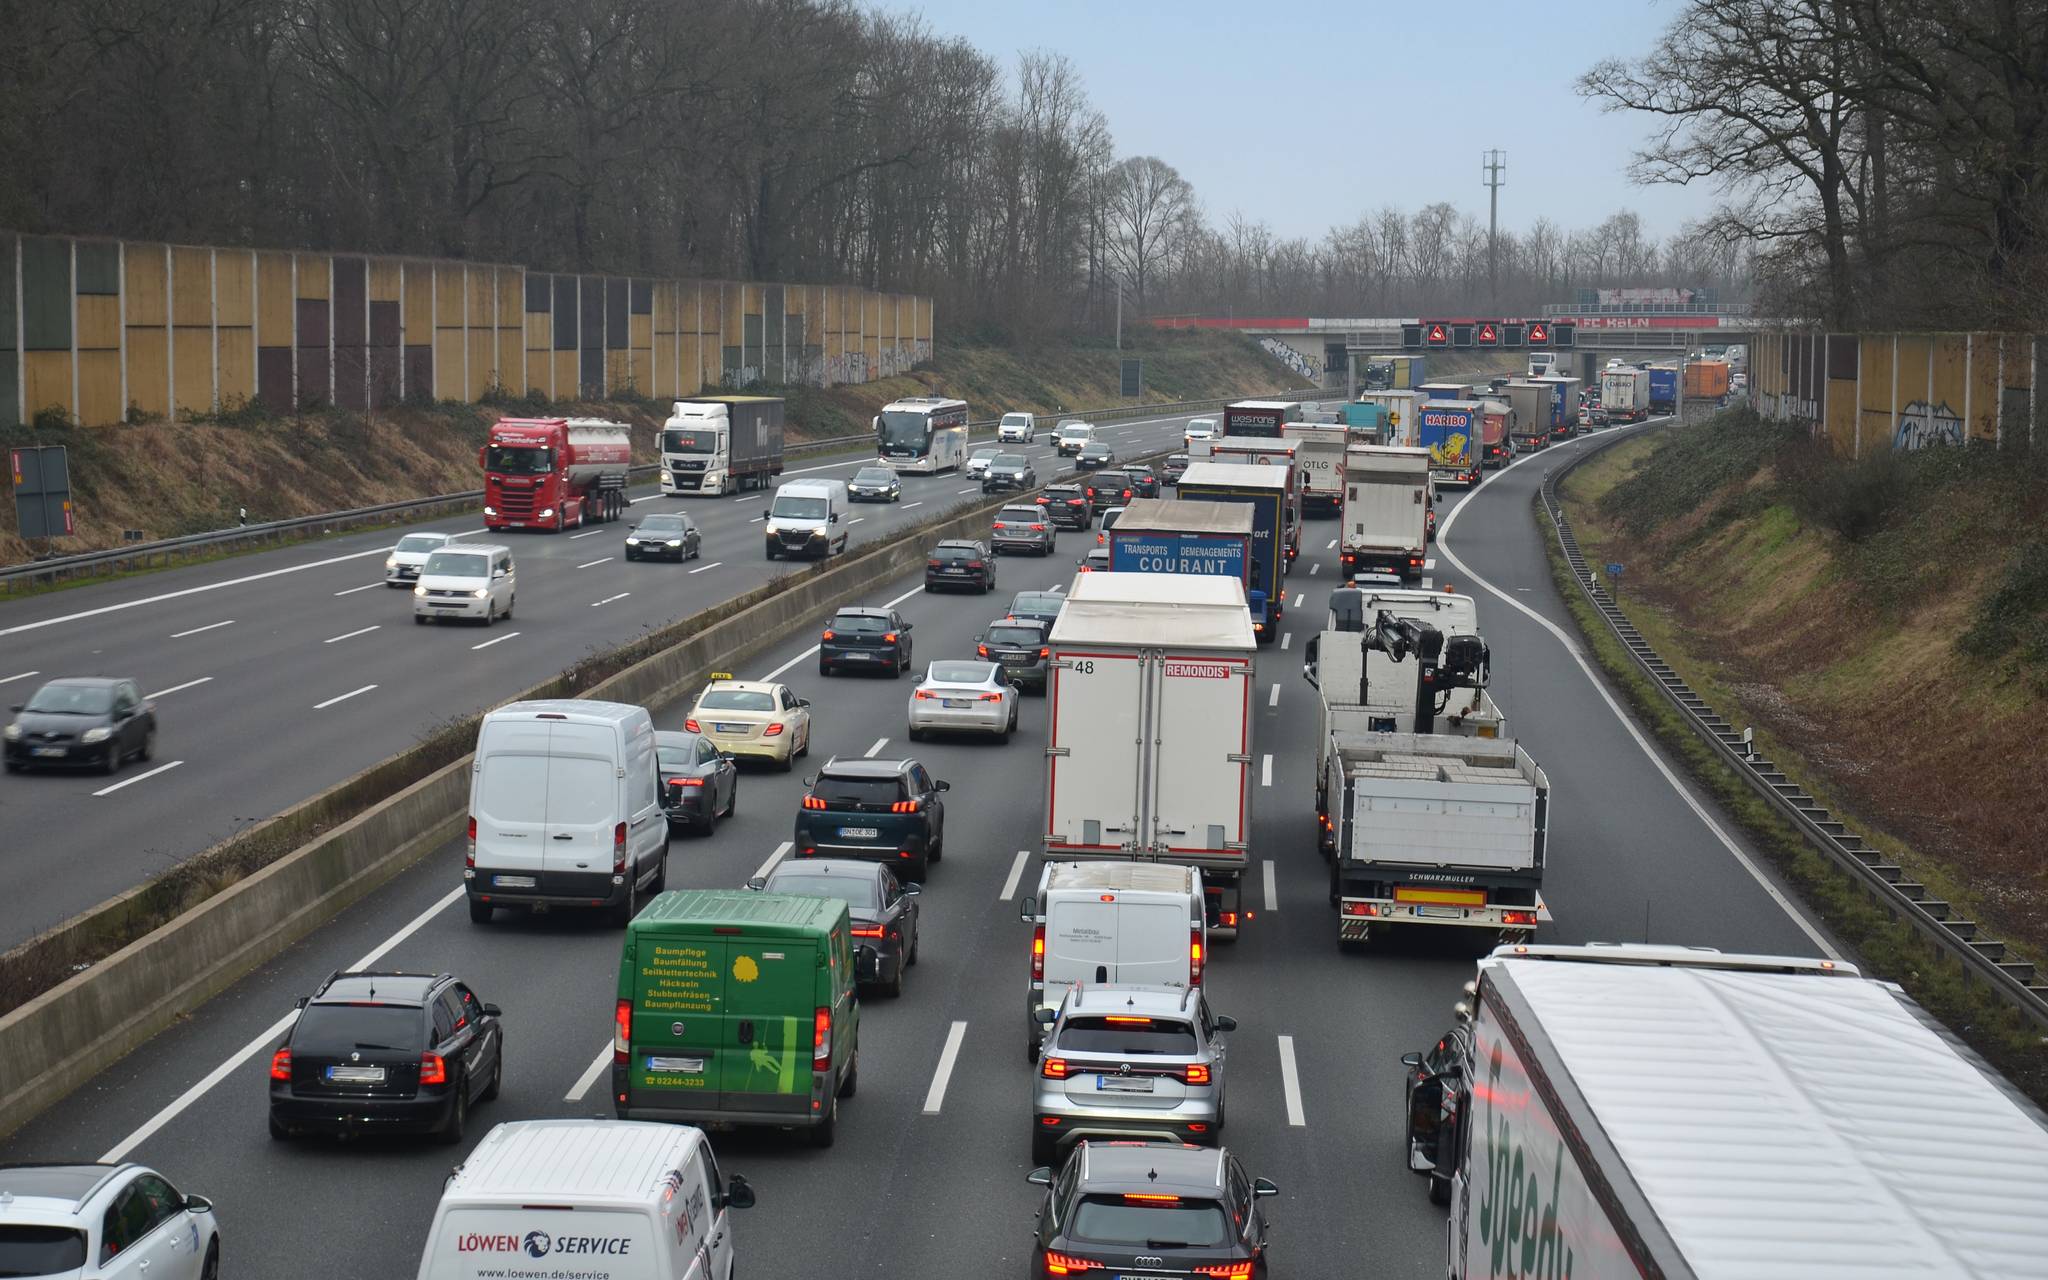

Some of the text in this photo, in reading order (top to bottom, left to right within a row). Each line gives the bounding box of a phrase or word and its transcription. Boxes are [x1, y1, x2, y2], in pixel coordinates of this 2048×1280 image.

[1426, 414, 1467, 427] HARIBO
[1303, 461, 1329, 469] OTLG
[1124, 544, 1168, 555] TRANSPORTS
[1180, 546, 1241, 558] DEMENAGEMENTS
[1139, 557, 1227, 574] COURANT
[1075, 661, 1094, 674] 48
[655, 946, 706, 957] Baumpflege
[653, 957, 708, 968] Baumfällung
[642, 967, 717, 978] Seilklettertechnik
[660, 979, 699, 988] Häckseln
[647, 989, 710, 999] Stubbenfräsen
[645, 1000, 712, 1012] Baumpflanzung
[458, 1232, 631, 1255] LÖWEN SERVICE
[477, 1269, 610, 1280] www.loewen.de/service
